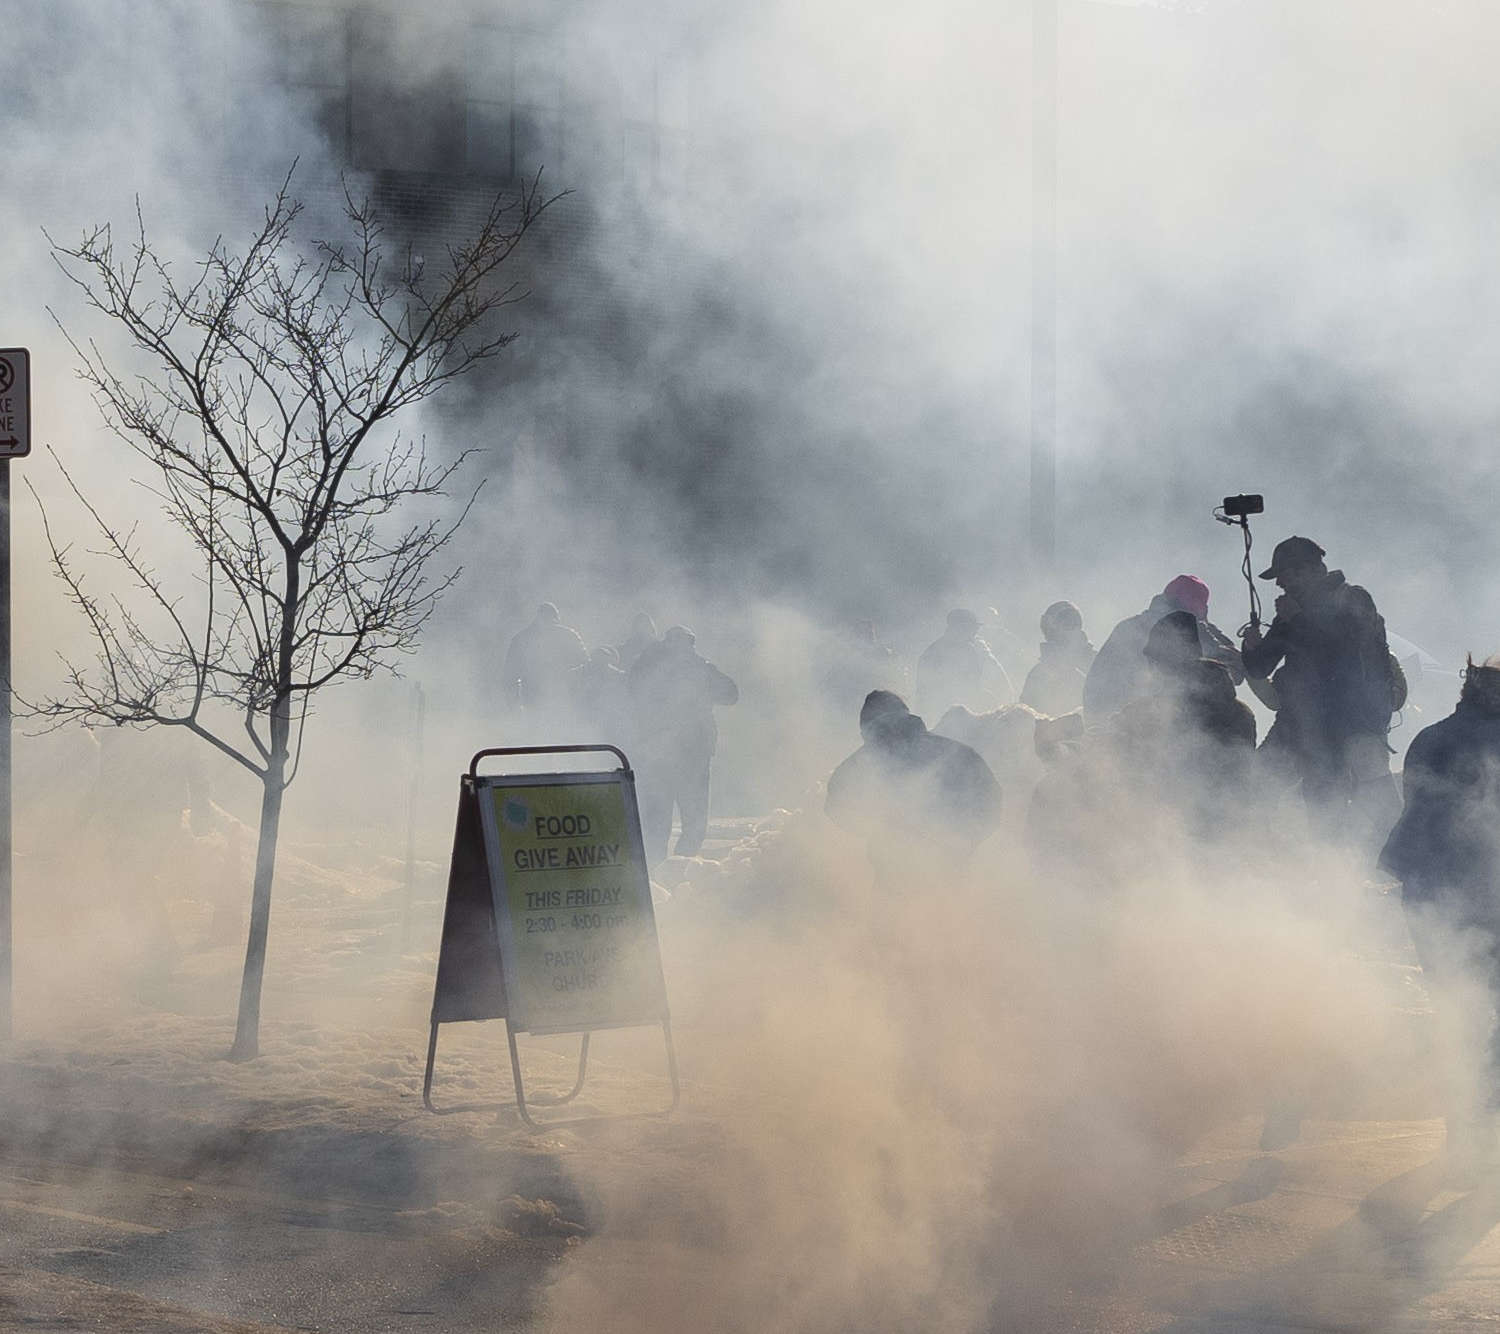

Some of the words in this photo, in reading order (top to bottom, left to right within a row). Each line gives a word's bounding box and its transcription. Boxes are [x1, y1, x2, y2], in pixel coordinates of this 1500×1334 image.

[535, 814, 591, 837] FOOD
[514, 848, 562, 869] GIVE
[565, 843, 620, 868] AWAY
[525, 890, 561, 908] THIS
[565, 886, 622, 906] FRIDAY
[525, 916, 557, 933] 2:30
[571, 913, 602, 930] 4:00
[544, 950, 587, 967] PARK
[552, 974, 622, 992] CHURC
